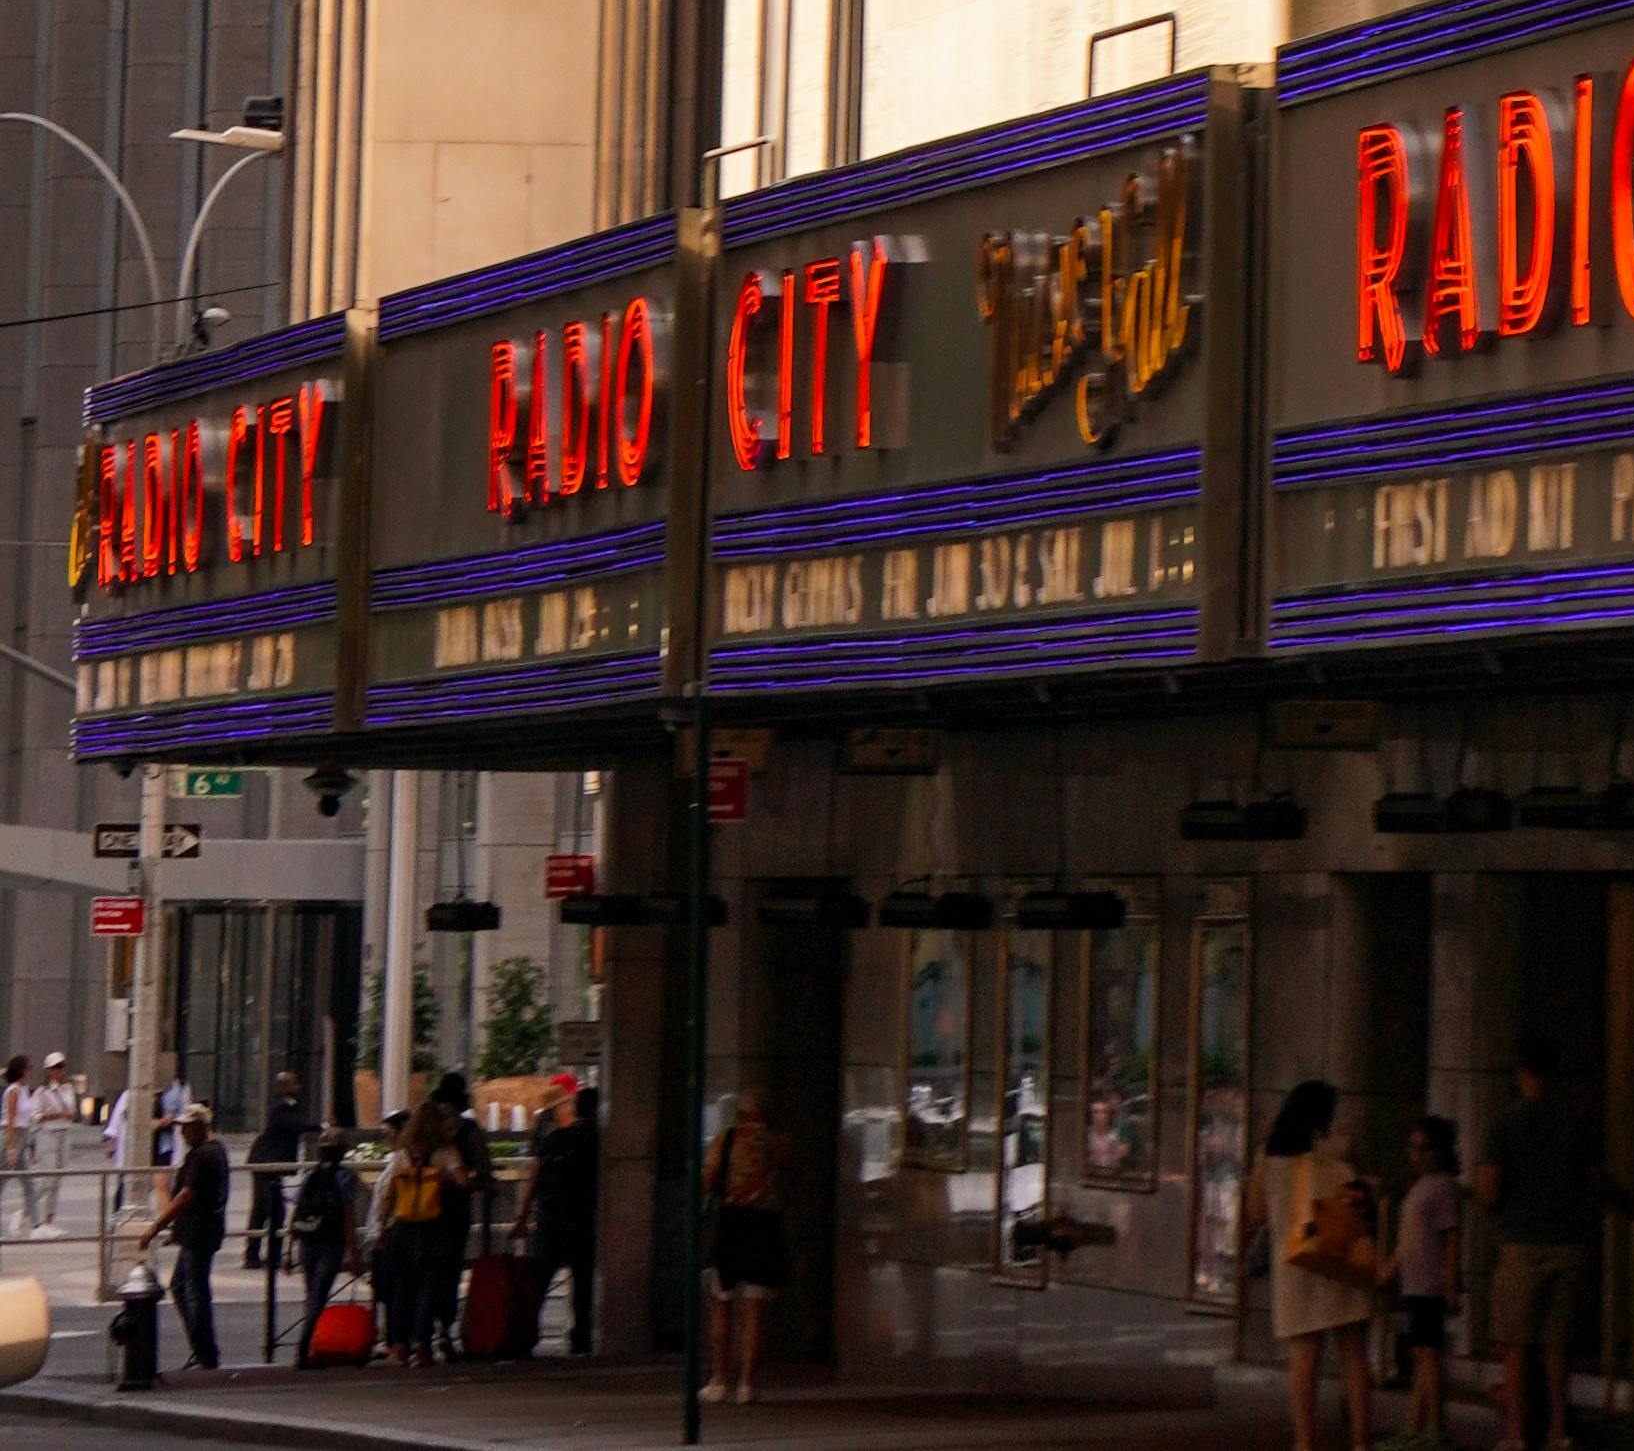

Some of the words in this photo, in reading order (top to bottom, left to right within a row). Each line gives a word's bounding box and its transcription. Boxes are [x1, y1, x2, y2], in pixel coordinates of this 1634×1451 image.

[487, 296, 656, 517] RADIO
[727, 238, 889, 471] CITY
[97, 421, 204, 594] RADIO
[225, 380, 326, 563] CITY
[1373, 478, 1449, 568] FIRST
[1464, 470, 1517, 558] AID
[193, 775, 211, 794] 6
